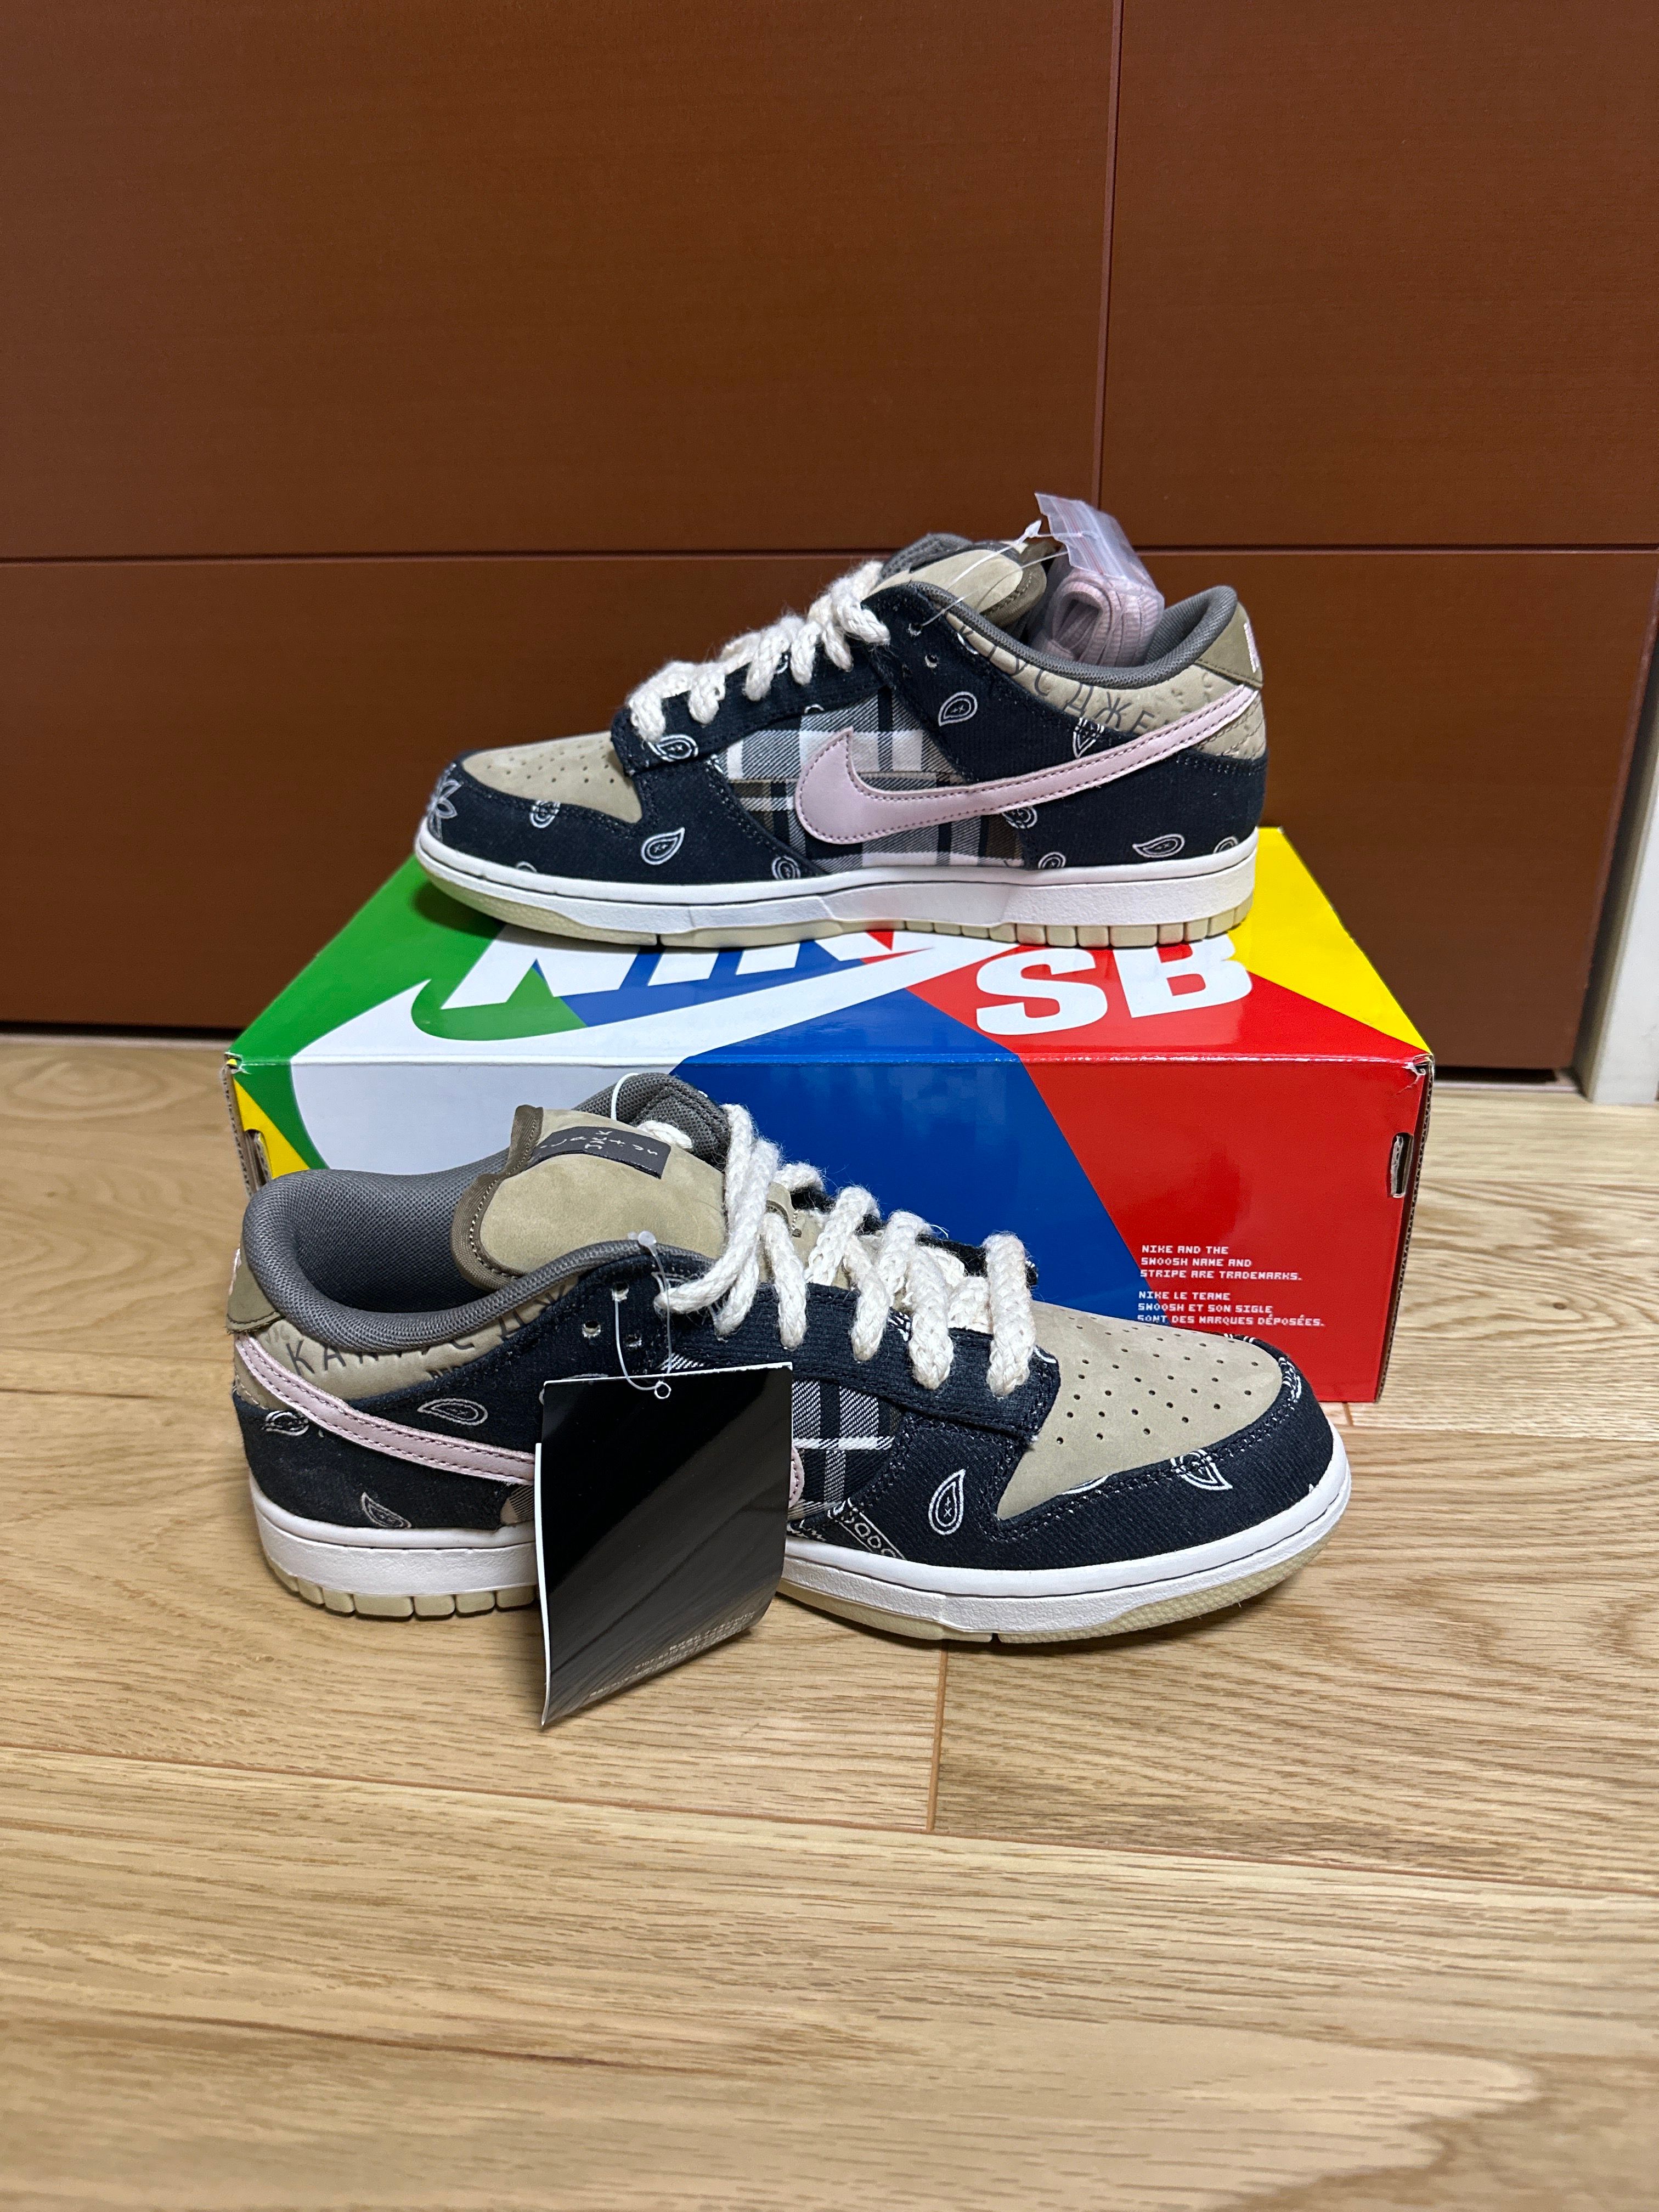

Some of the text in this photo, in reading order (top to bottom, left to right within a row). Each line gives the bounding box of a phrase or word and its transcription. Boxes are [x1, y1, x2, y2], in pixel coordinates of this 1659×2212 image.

[976, 934, 1252, 1035] SB
[1142, 1245, 1229, 1255] NIKE AND THE
[1141, 1257, 1252, 1267] SWOOSH NAME AND
[1140, 1269, 1302, 1280] STRIPE ARE TRADEMARKS.
[1138, 1291, 1231, 1301] NIKE LE TERME
[1138, 1303, 1273, 1313] SWOOSH ET SON SIGLE
[1137, 1314, 1325, 1327] SONT DES MARQUES DÉPOSÉES.
